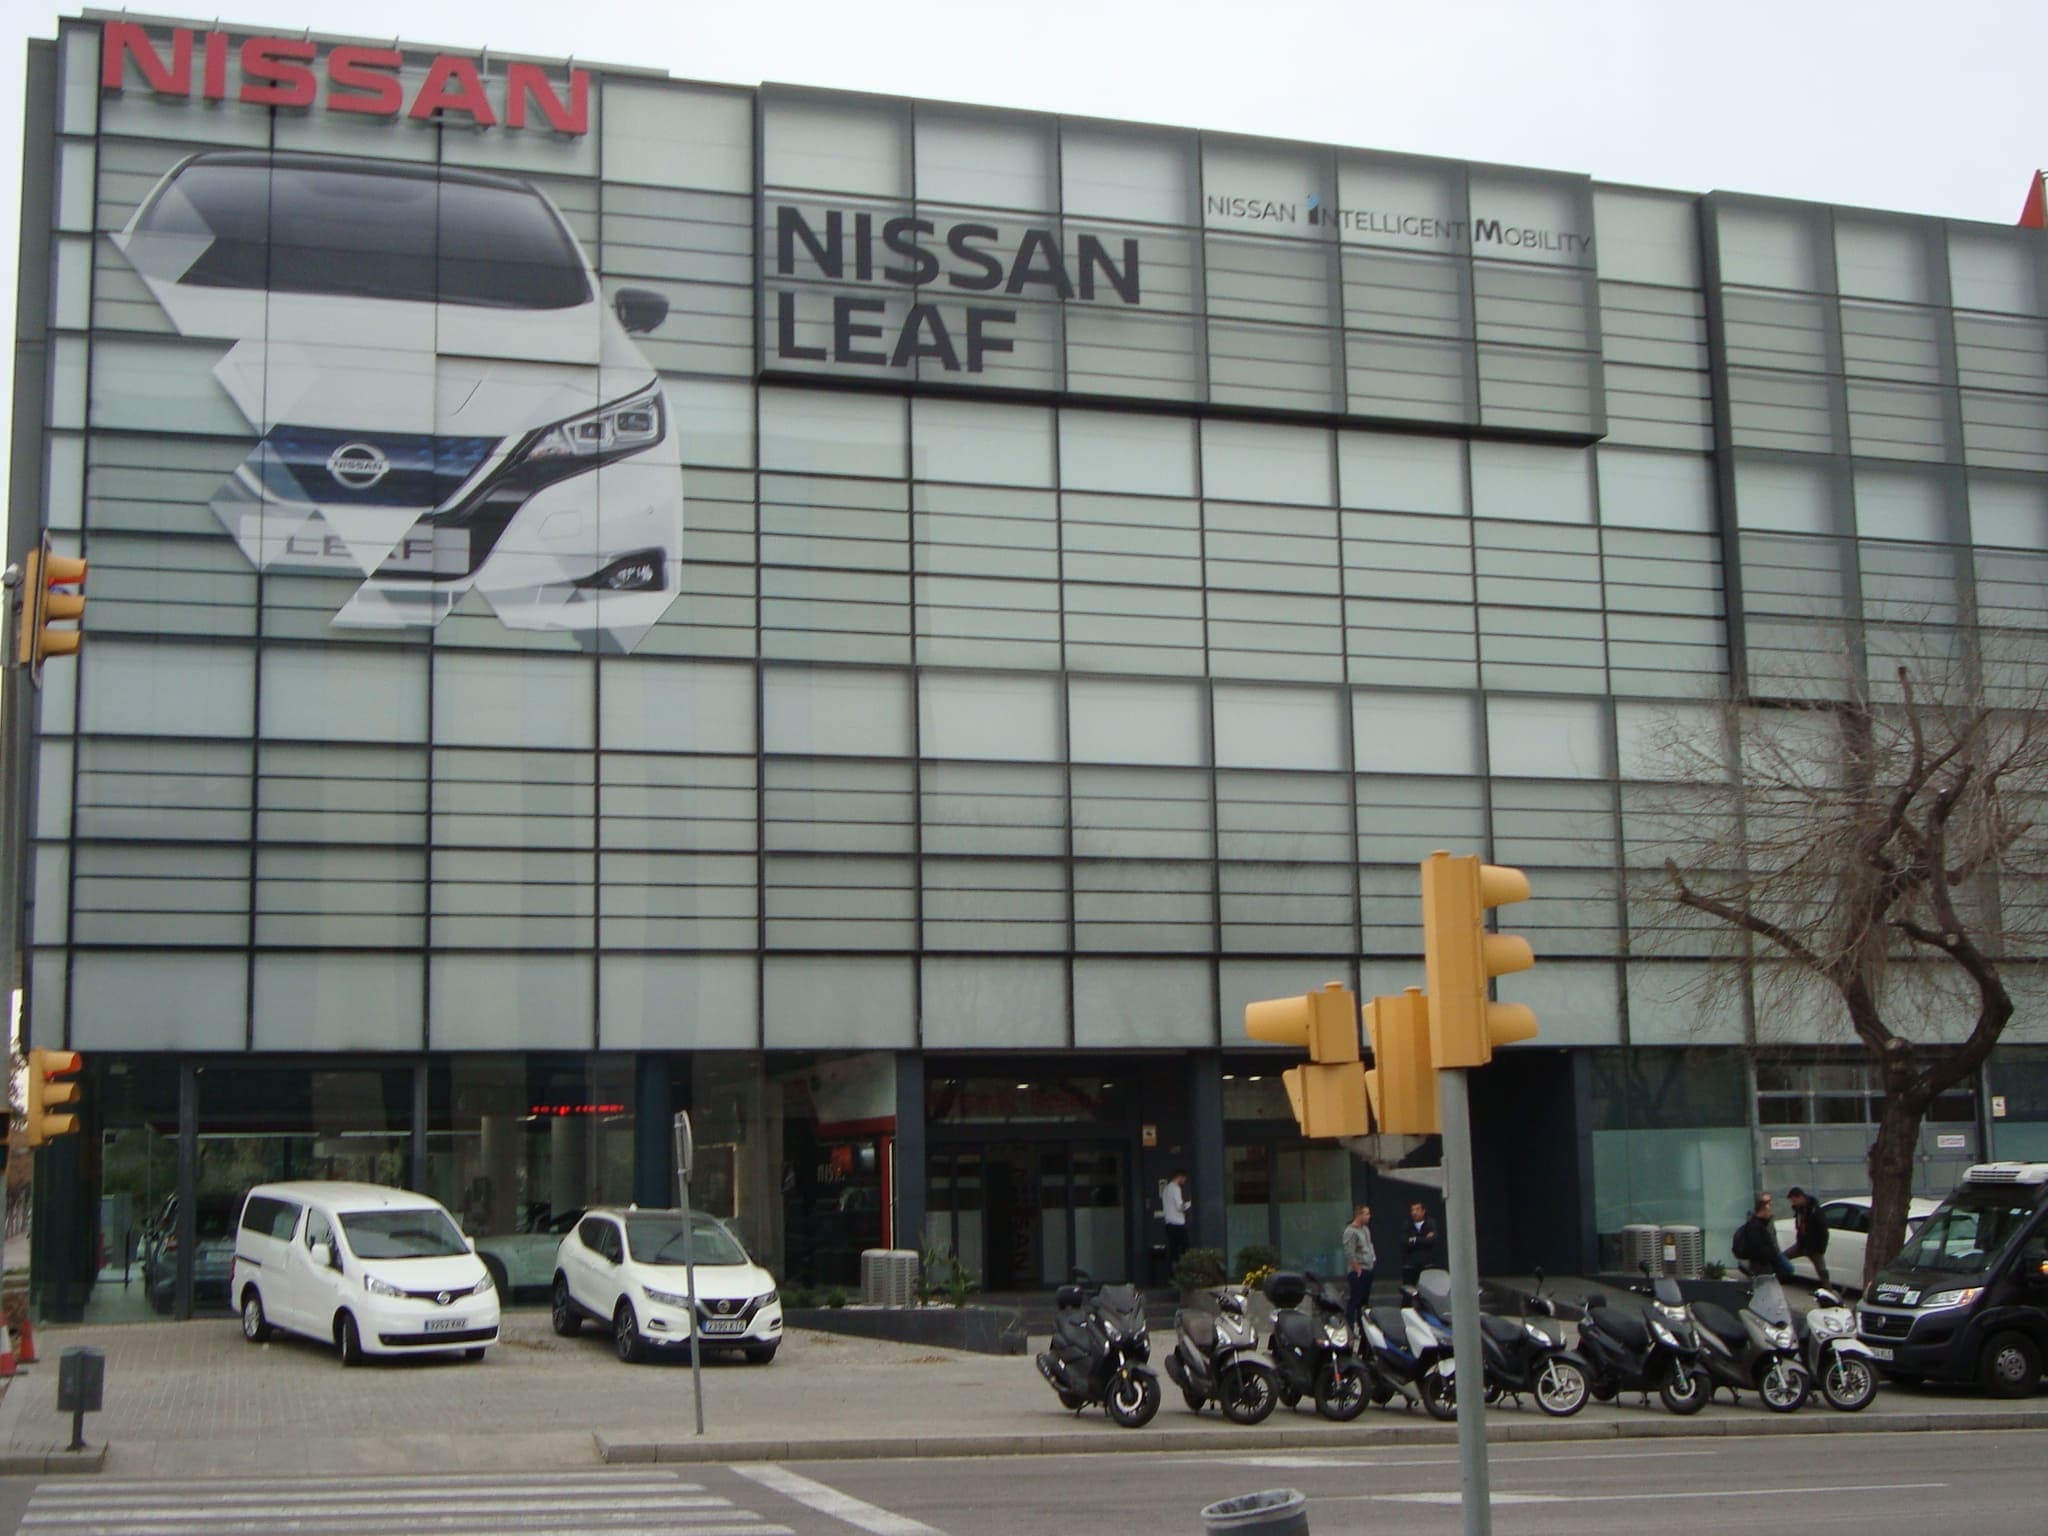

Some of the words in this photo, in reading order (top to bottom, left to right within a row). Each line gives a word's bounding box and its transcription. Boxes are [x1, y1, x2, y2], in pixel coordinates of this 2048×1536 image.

[102, 20, 590, 136] NISSAN
[776, 205, 1140, 305] NISSAN
[1206, 195, 1297, 224] NISSAN
[1473, 217, 1592, 252] MOBILITY
[777, 291, 1017, 373] LEAF
[285, 534, 434, 561] LEF
